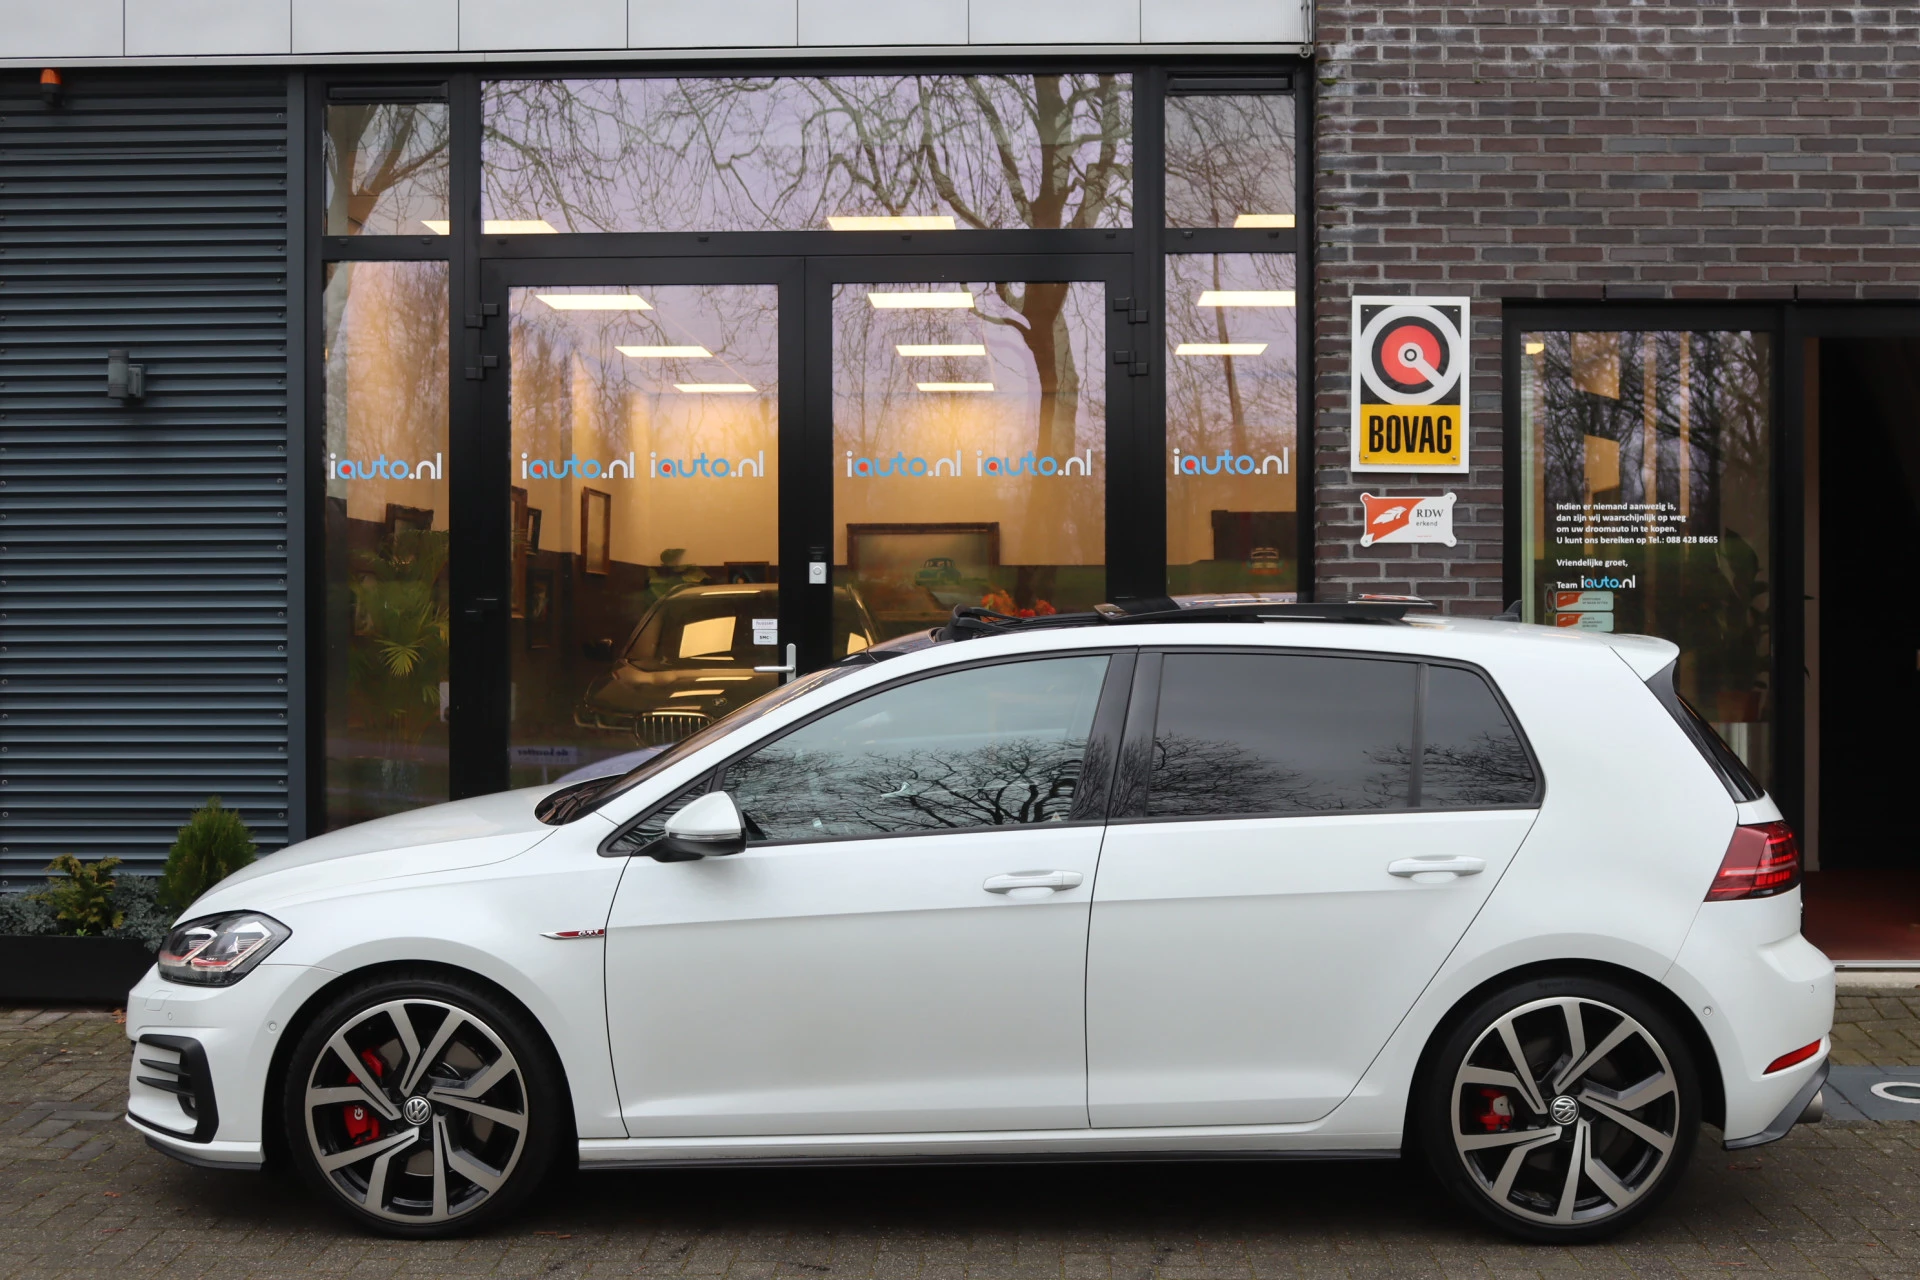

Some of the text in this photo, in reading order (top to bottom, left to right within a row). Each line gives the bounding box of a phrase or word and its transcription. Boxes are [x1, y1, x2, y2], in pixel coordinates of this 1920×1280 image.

[1369, 414, 1453, 454] BOVAG
[330, 452, 442, 480] iauto.nl
[522, 452, 635, 480] iauto.nl
[650, 450, 764, 478] iauto.nl
[846, 450, 962, 478] iauto.nl
[976, 449, 1092, 477] iauto.nl
[1173, 447, 1290, 475] iauto.nl
[1415, 508, 1444, 518] RDW
[1557, 502, 1677, 512] Indien er niemand aanwezig is,
[1556, 513, 1687, 524] dan zijn wij waarschijnlijk op weg
[1585, 524, 1630, 533] droomauto
[1631, 524, 1639, 533] in
[1640, 525, 1649, 533] te
[1650, 524, 1677, 534] kopen.
[1557, 535, 1719, 546] U kunt ons bereiken op Tel.: 088 428 8665
[1557, 558, 1629, 568] Vriendelijke groet,
[1557, 575, 1635, 589] Team iauto.nl
